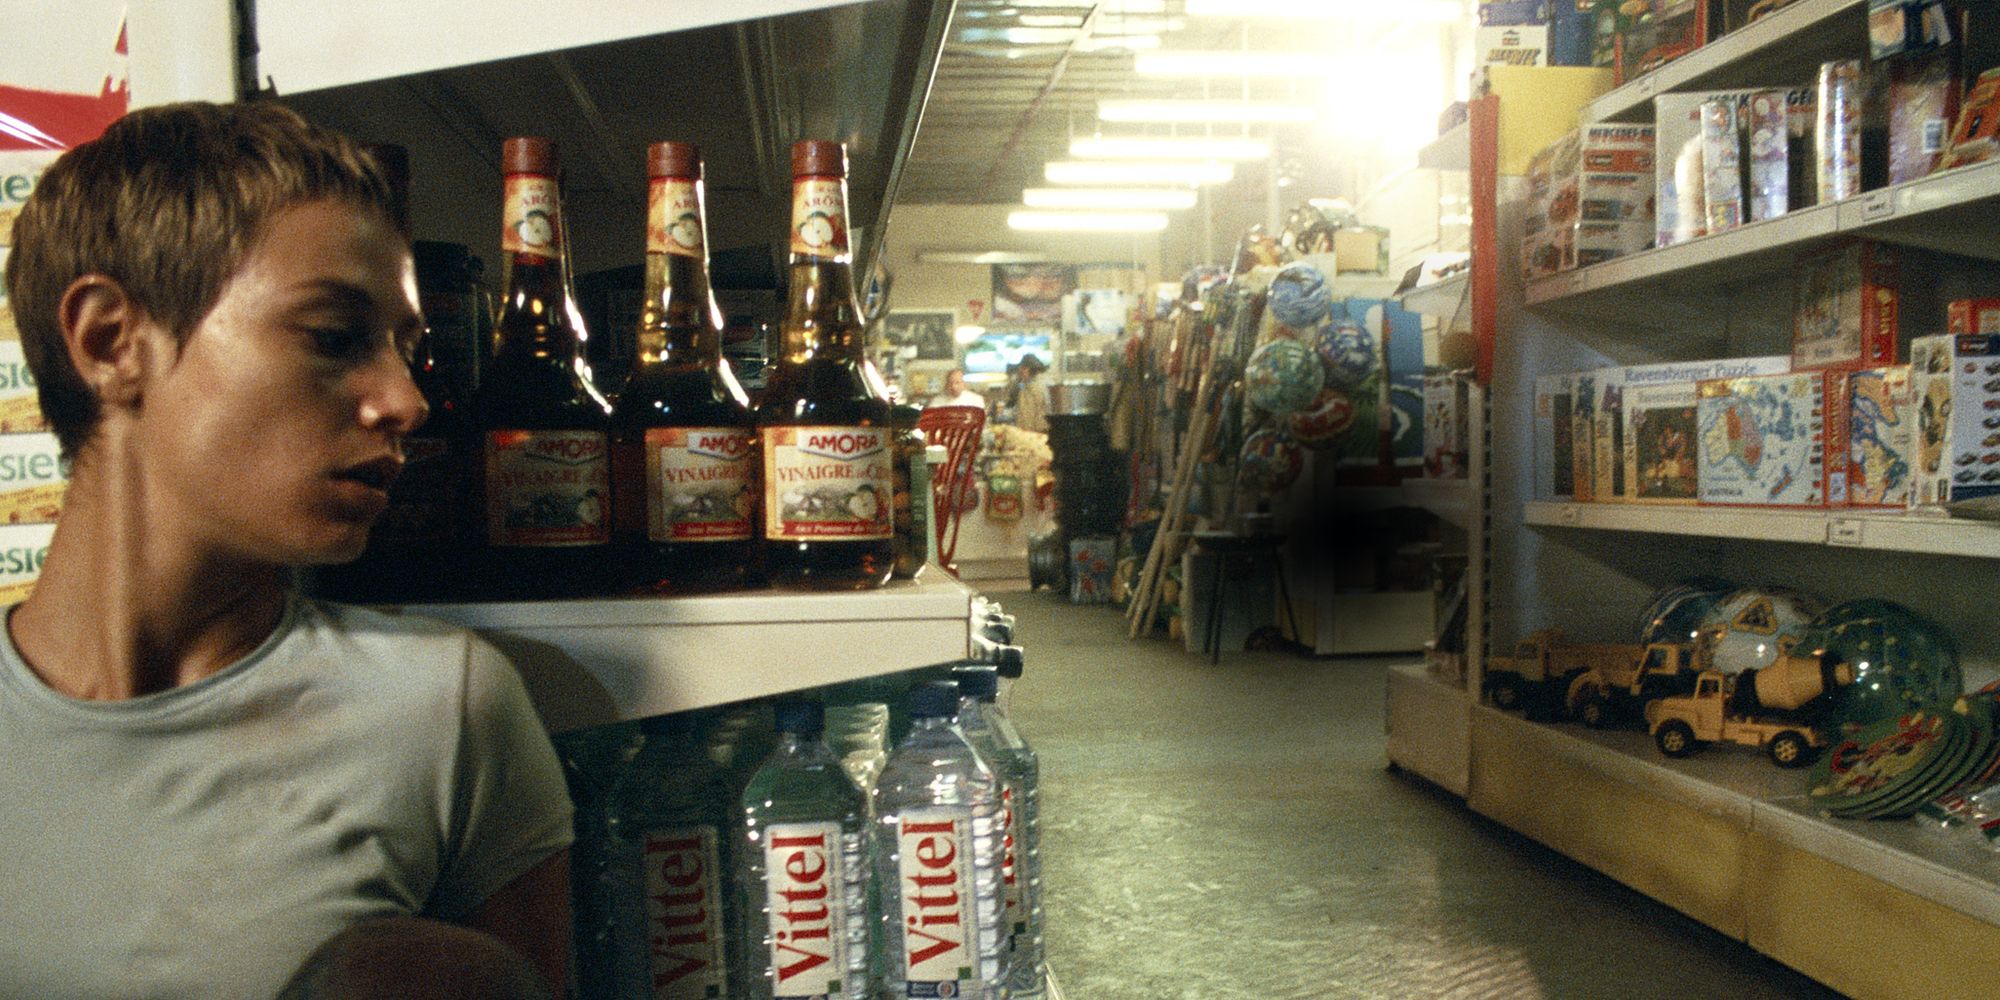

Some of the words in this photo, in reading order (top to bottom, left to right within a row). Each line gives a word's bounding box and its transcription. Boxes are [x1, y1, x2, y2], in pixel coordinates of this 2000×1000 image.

[777, 463, 853, 482] VINAIGRE
[808, 433, 878, 454] AMORA
[646, 837, 710, 988] Vittel
[771, 832, 831, 984] Vittel
[902, 817, 961, 968] Vittel
